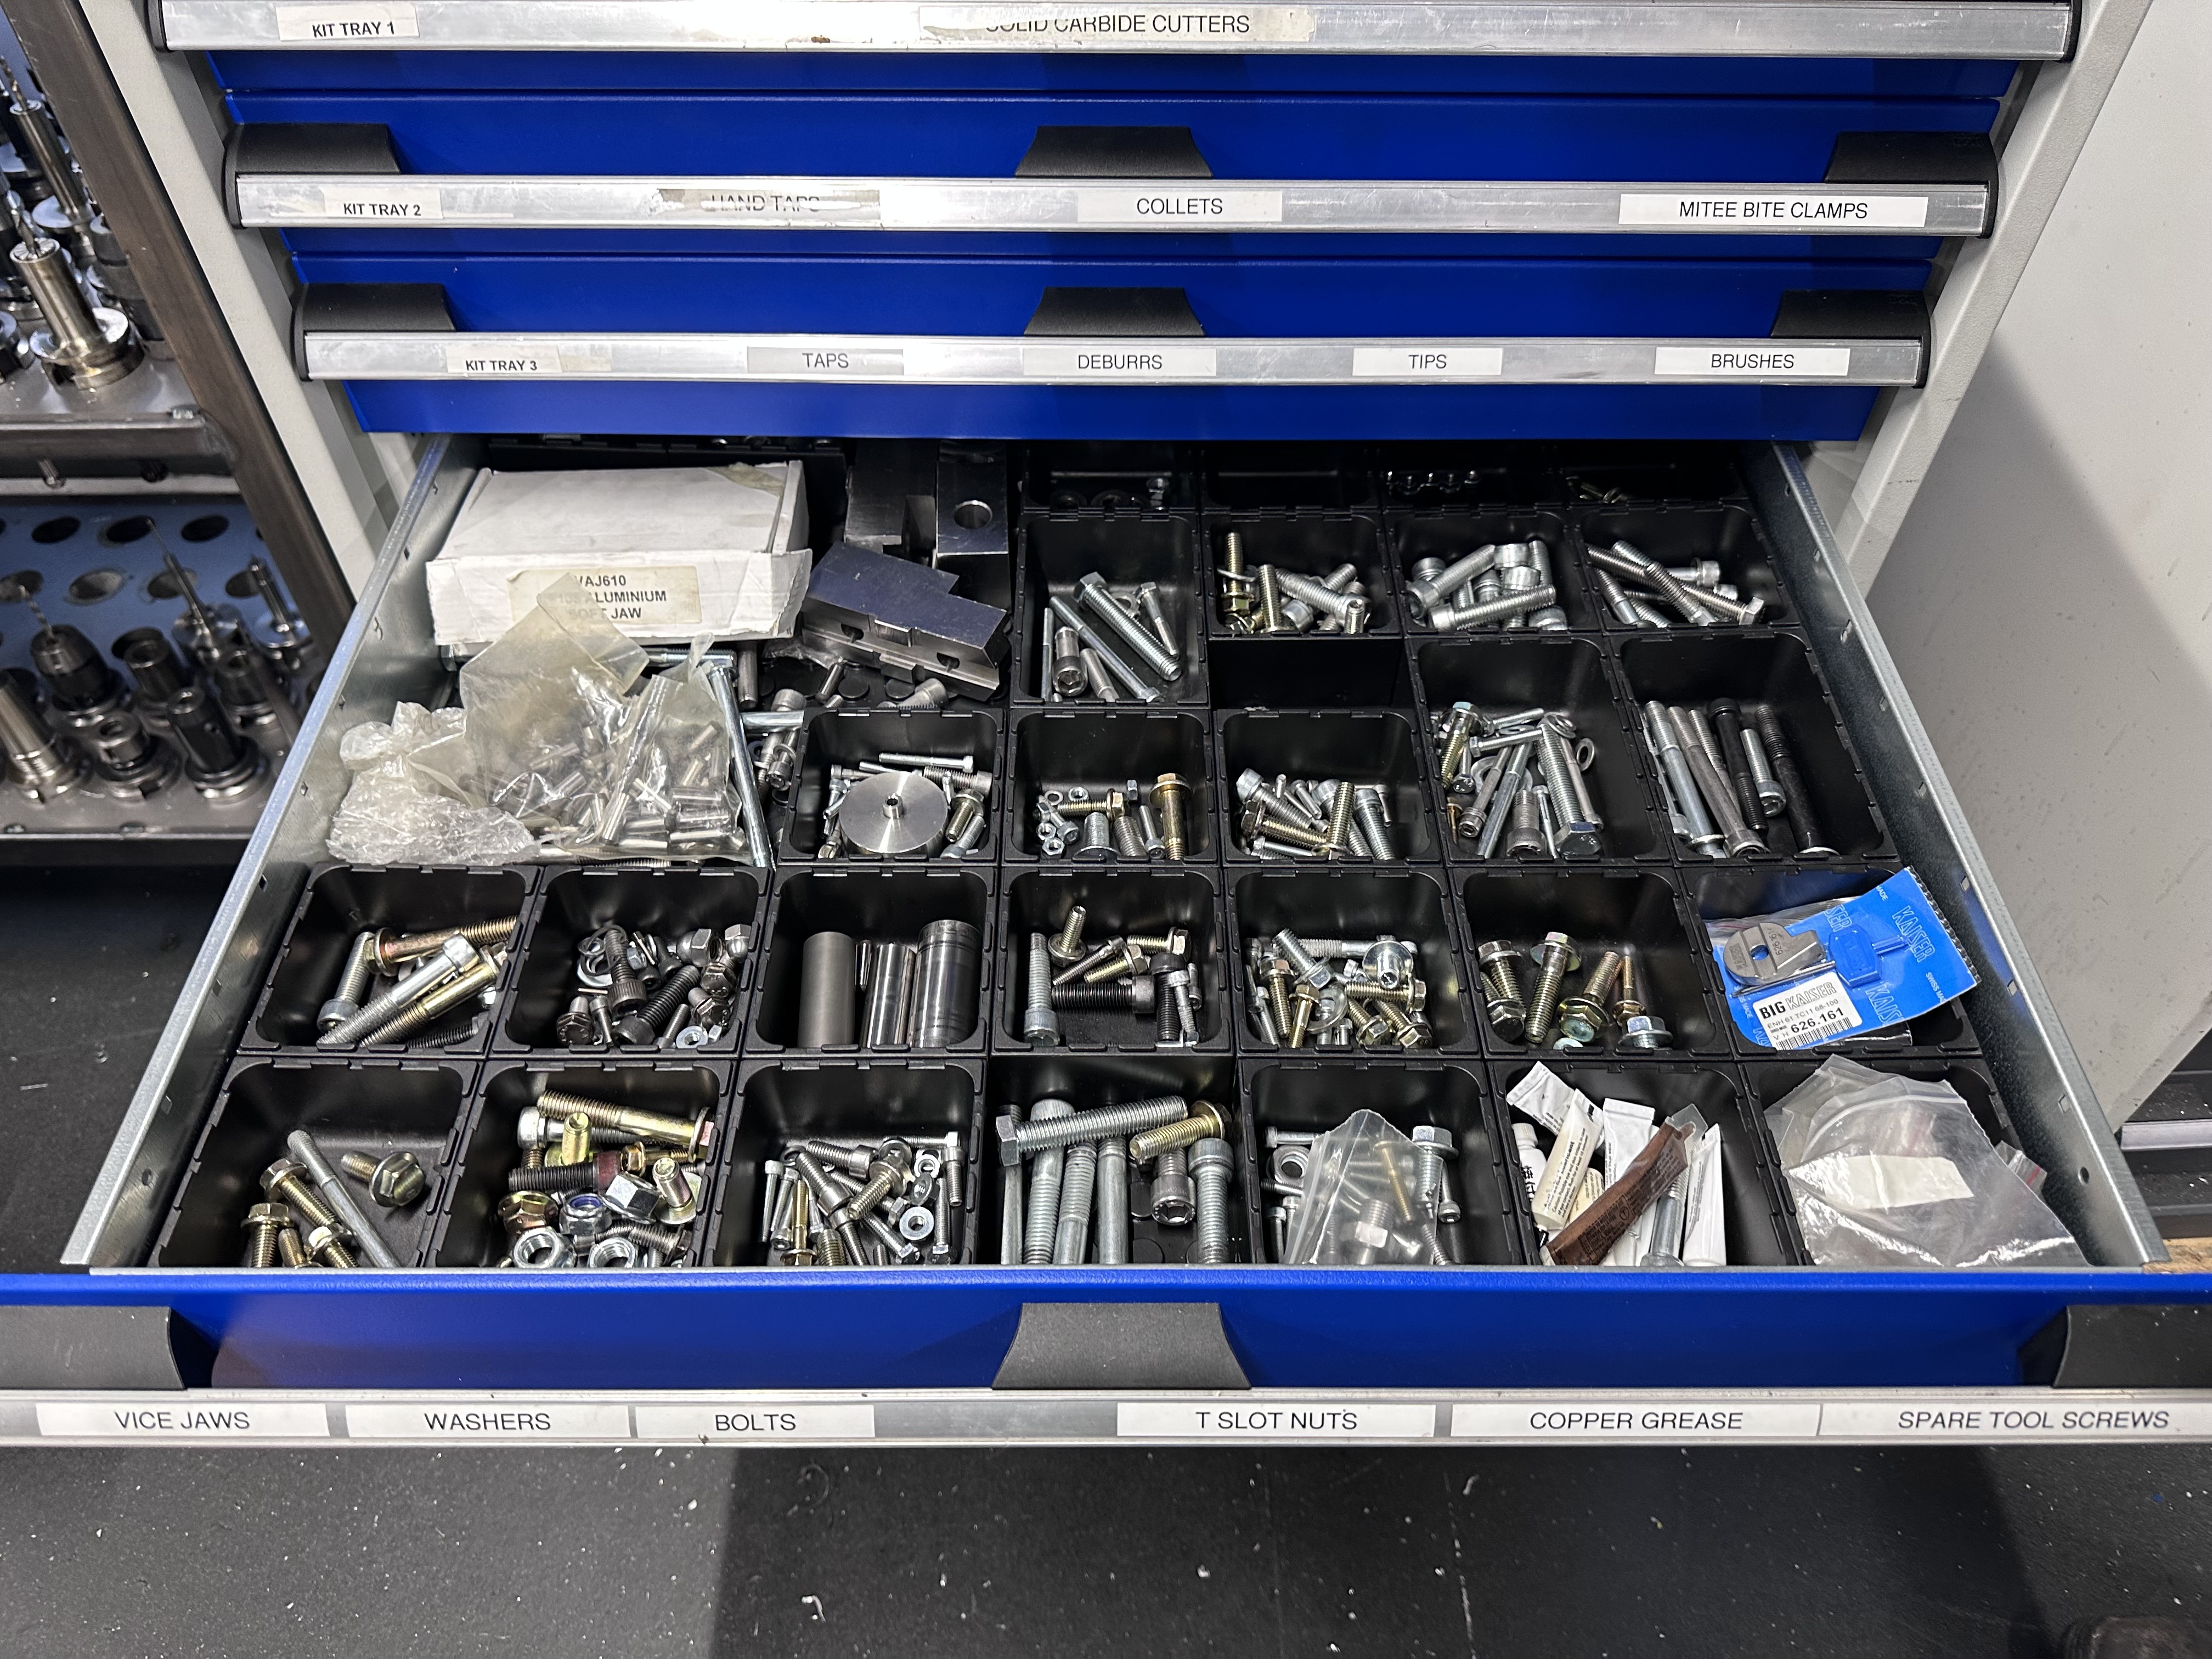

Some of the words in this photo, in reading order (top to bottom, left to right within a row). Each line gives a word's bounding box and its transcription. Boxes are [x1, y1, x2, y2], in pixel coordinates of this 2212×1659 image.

[312, 24, 335, 37] KIT
[340, 22, 381, 36] TRAY
[390, 22, 394, 34] 1
[986, 19, 1048, 32] LID
[1054, 15, 1146, 32] CARBIDE
[1153, 15, 1250, 33] CUTTERS
[343, 204, 363, 215] KIT
[370, 204, 408, 216] TRAY
[413, 205, 421, 216] 2
[1137, 198, 1223, 215] COLLETS
[1680, 201, 1738, 217] MITEE
[1743, 202, 1786, 218] BITE
[1791, 202, 1868, 219] CLAMPS
[466, 360, 484, 371] KIT
[488, 360, 525, 371] TRAY
[530, 360, 537, 371] 3
[805, 353, 849, 368] TAPS
[1077, 354, 1163, 369] DEBURRS
[1408, 354, 1447, 369] TIPS
[1711, 354, 1795, 369] BRUSHES
[611, 607, 642, 619] JAW
[1892, 905, 1935, 963] KAISER
[1759, 1001, 1786, 1019] BIG
[1785, 982, 1837, 1011] KAISER
[1865, 982, 1905, 1027] KAIS
[1767, 1019, 1784, 1029] ENH
[1790, 1007, 1844, 1033] 626.161
[115, 1412, 169, 1429] VICE
[180, 1412, 250, 1429] JAWS
[424, 1413, 551, 1430] WASHERS
[715, 1413, 797, 1431] BOLTS
[1195, 1412, 1211, 1429] T
[1218, 1412, 1283, 1429] SLOT
[1290, 1412, 1357, 1430] NUTS
[1530, 1412, 1633, 1429] COPPER
[1641, 1412, 1743, 1429] GREASE
[1898, 1412, 1981, 1429] SPARE
[1991, 1412, 2052, 1428] TOOL
[2062, 1412, 2170, 1429] SCREWS
